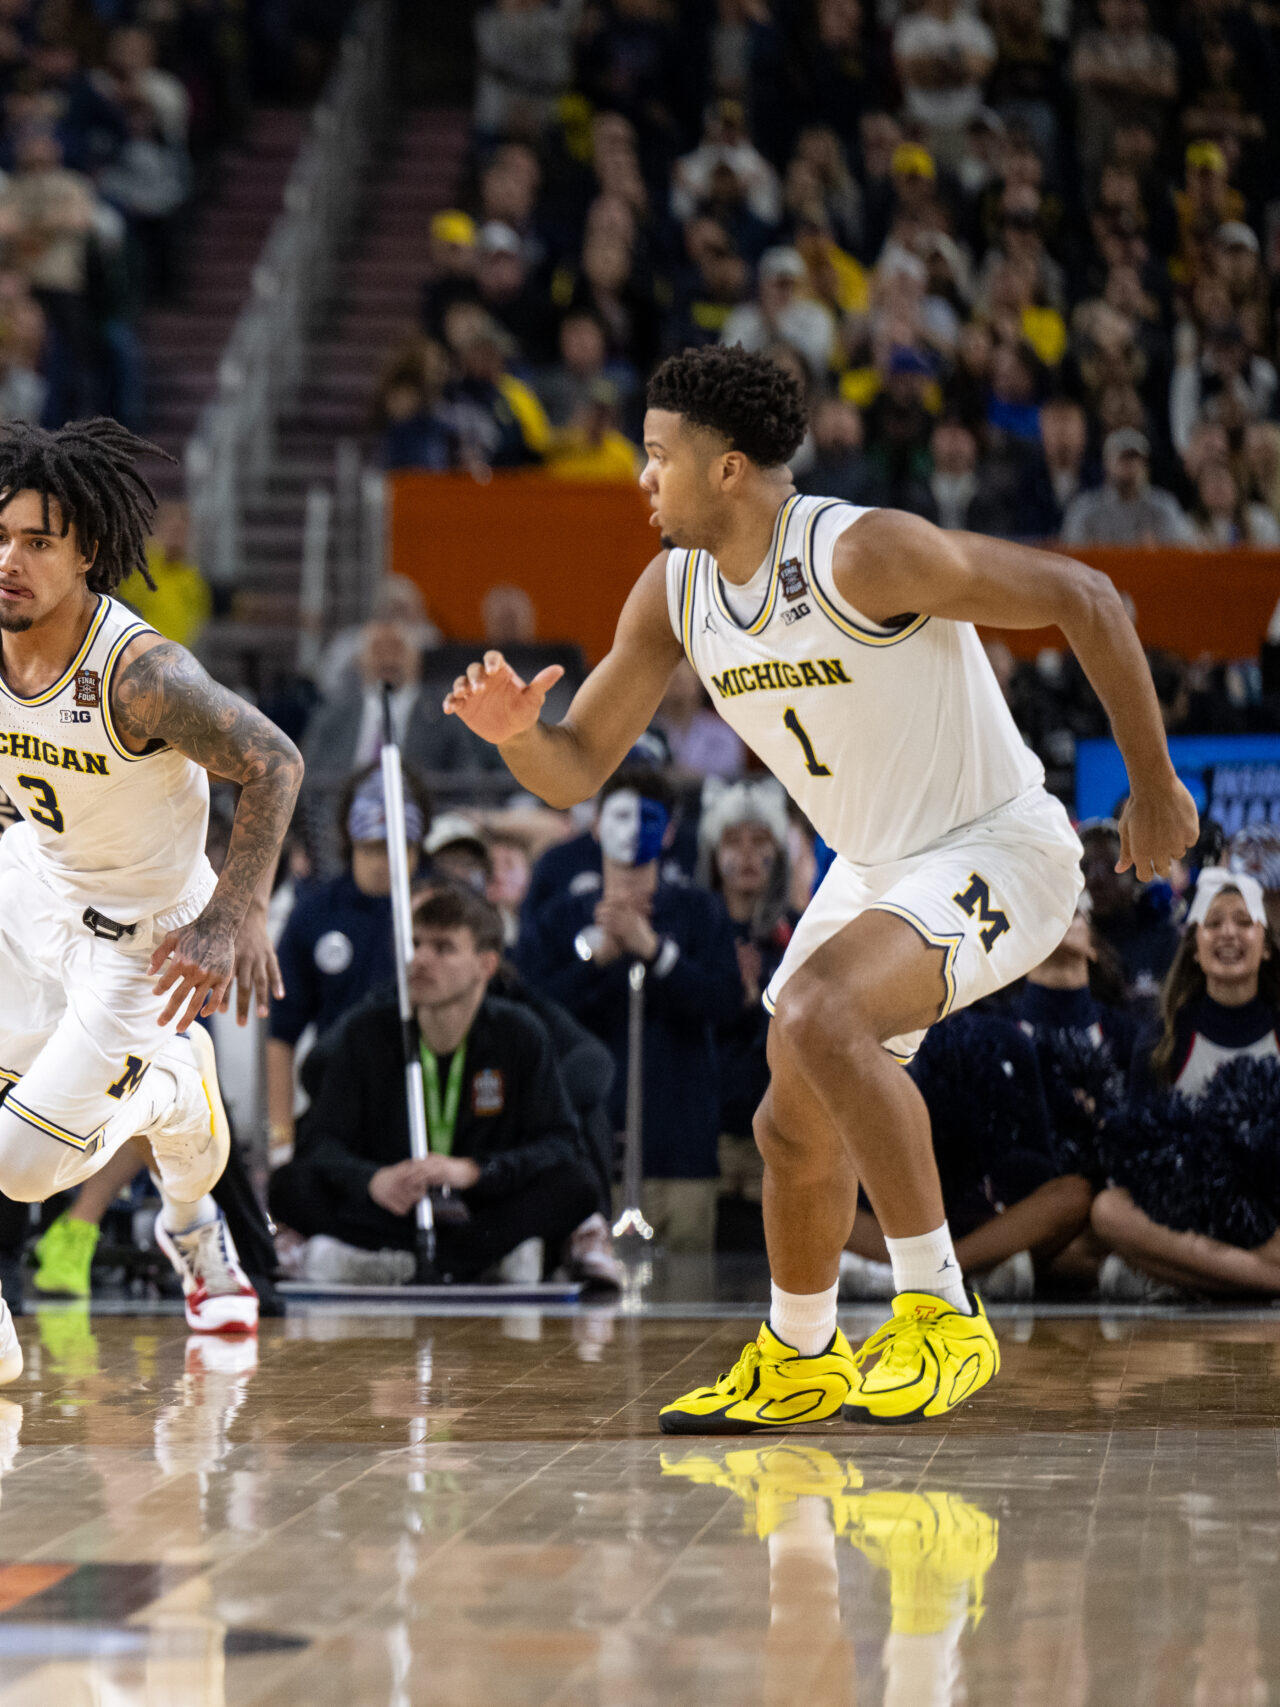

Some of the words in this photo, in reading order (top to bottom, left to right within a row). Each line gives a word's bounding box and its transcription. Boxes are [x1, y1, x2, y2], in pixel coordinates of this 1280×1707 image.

[77, 677, 96, 686] FINAL
[77, 692, 97, 702] FOUR
[711, 658, 853, 698] MICHIGAN
[783, 705, 833, 777] 1
[17, 773, 65, 834] 3
[951, 869, 1011, 954] M
